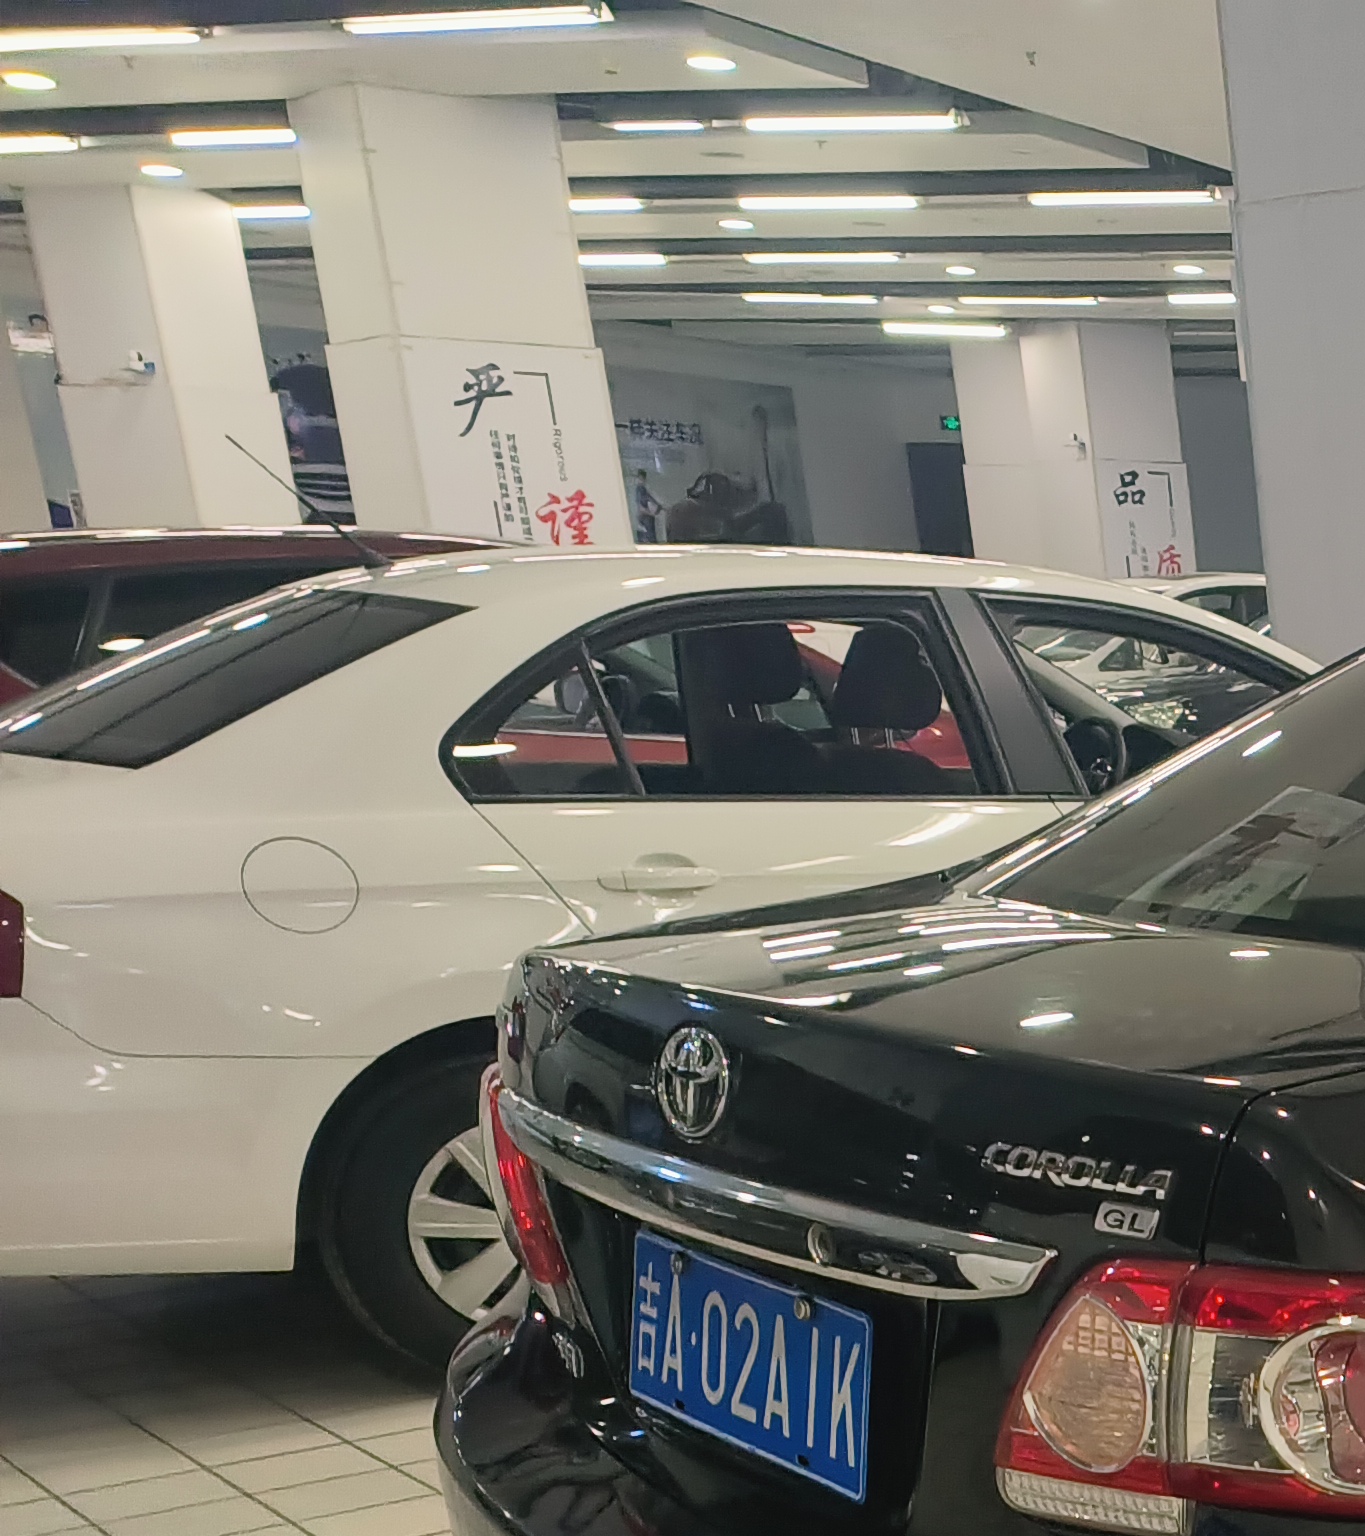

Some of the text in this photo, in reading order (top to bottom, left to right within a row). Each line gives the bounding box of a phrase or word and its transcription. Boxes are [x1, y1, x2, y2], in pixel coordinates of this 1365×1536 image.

[453, 362, 513, 437] 严
[1113, 470, 1146, 507] 品
[535, 489, 598, 547] 谨
[980, 1142, 1174, 1200] COROLLA
[1103, 1209, 1145, 1234] GL
